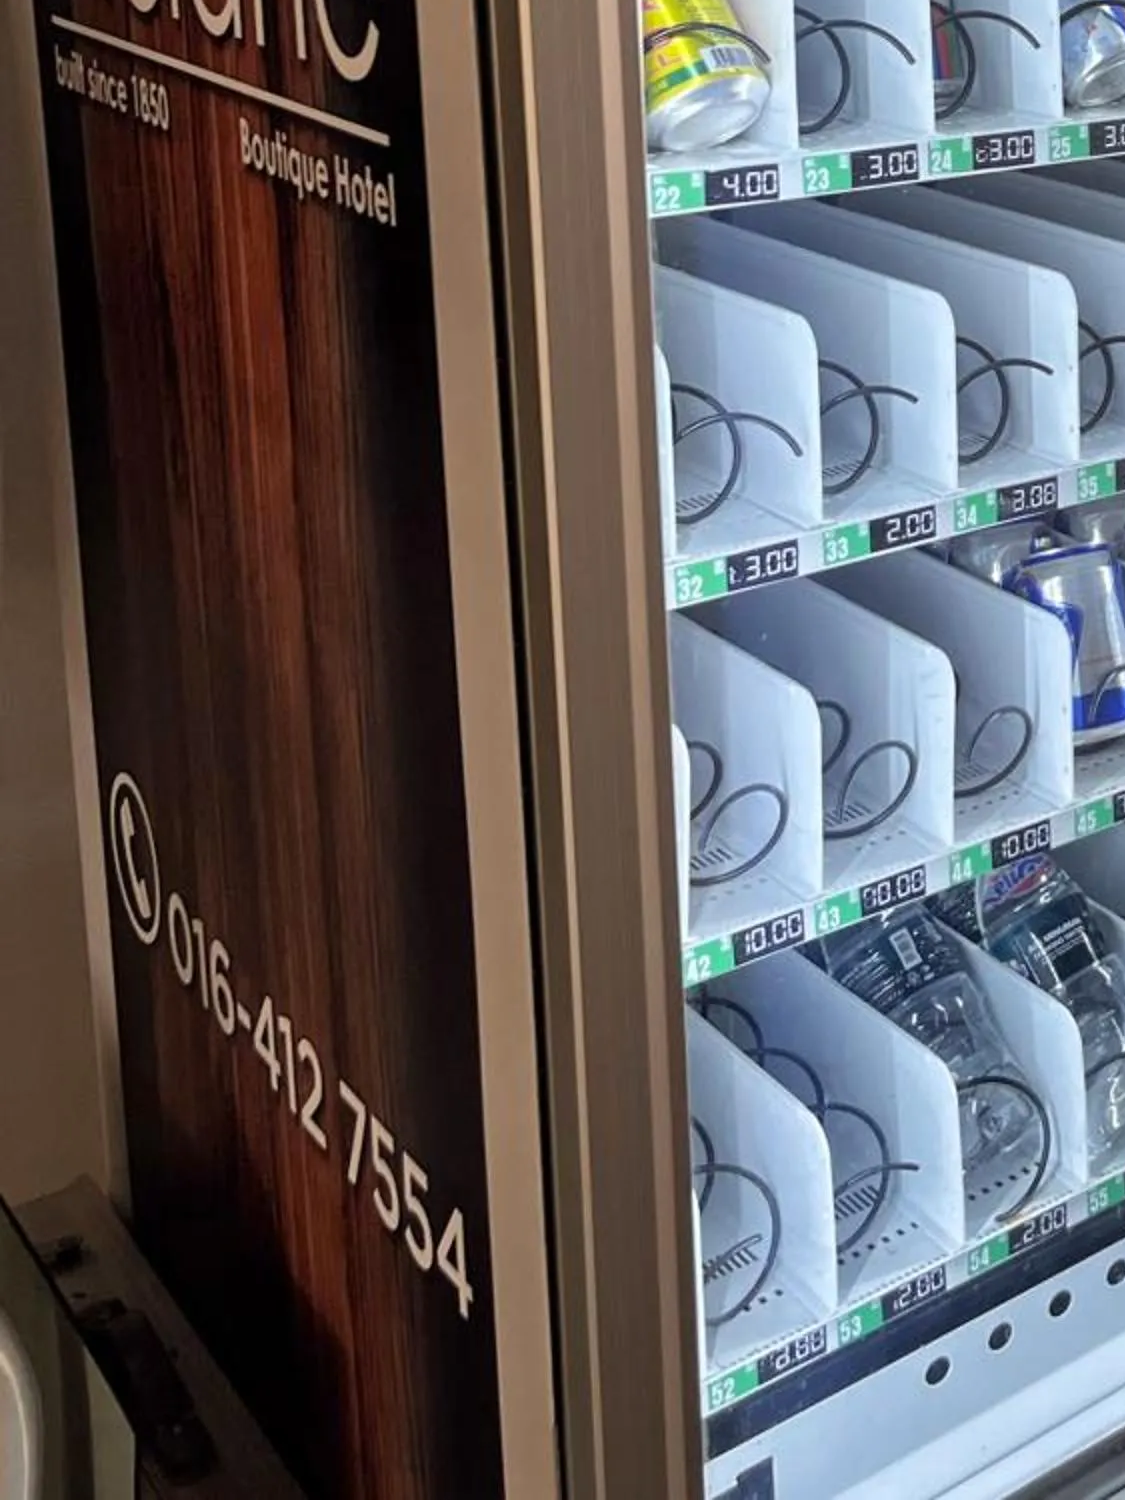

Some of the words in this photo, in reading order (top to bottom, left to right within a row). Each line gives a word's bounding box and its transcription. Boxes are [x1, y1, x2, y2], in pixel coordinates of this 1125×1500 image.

[55, 44, 83, 87] built
[88, 59, 129, 112] since
[131, 75, 170, 131] 1850
[930, 150, 952, 174] 24
[1050, 137, 1072, 160] 25
[239, 116, 330, 199] Boutique
[333, 157, 397, 227] Hotel
[805, 167, 831, 192] 23
[867, 148, 918, 181] 3.00
[654, 186, 682, 211] 22
[721, 169, 777, 199] 4.00
[1077, 476, 1098, 499] 35
[956, 505, 978, 529] 34
[826, 538, 849, 562] 33
[886, 508, 935, 544] 2.00
[678, 576, 703, 601] 32
[744, 545, 798, 582] 3.00
[1077, 810, 1097, 833] 45
[952, 857, 973, 882] 44
[1002, 823, 1050, 859] 10.00
[818, 906, 840, 932] 43
[686, 955, 712, 980] 42
[744, 912, 803, 956] 10.00
[168, 891, 327, 1150] 016-412
[339, 1079, 474, 1322] 7554
[1089, 1189, 1108, 1213] 55
[970, 1246, 990, 1271] 54
[839, 1314, 862, 1342] 53
[711, 1376, 736, 1406] 52
